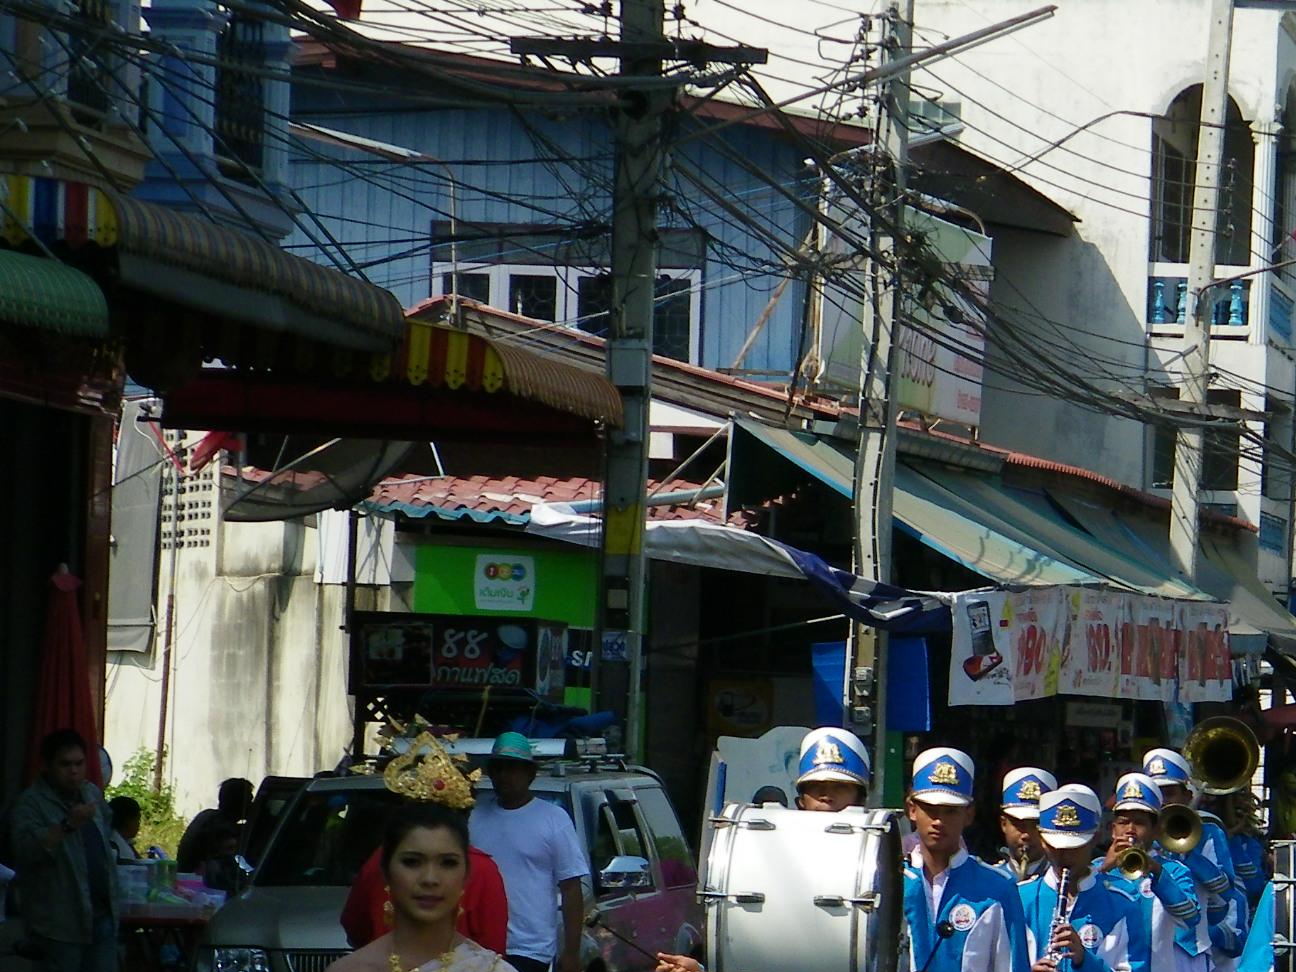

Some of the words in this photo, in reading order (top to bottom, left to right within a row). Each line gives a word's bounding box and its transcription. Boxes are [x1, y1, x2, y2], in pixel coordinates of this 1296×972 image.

[441, 629, 489, 659] ๘๘
[436, 661, 521, 685] กาแฟสด
